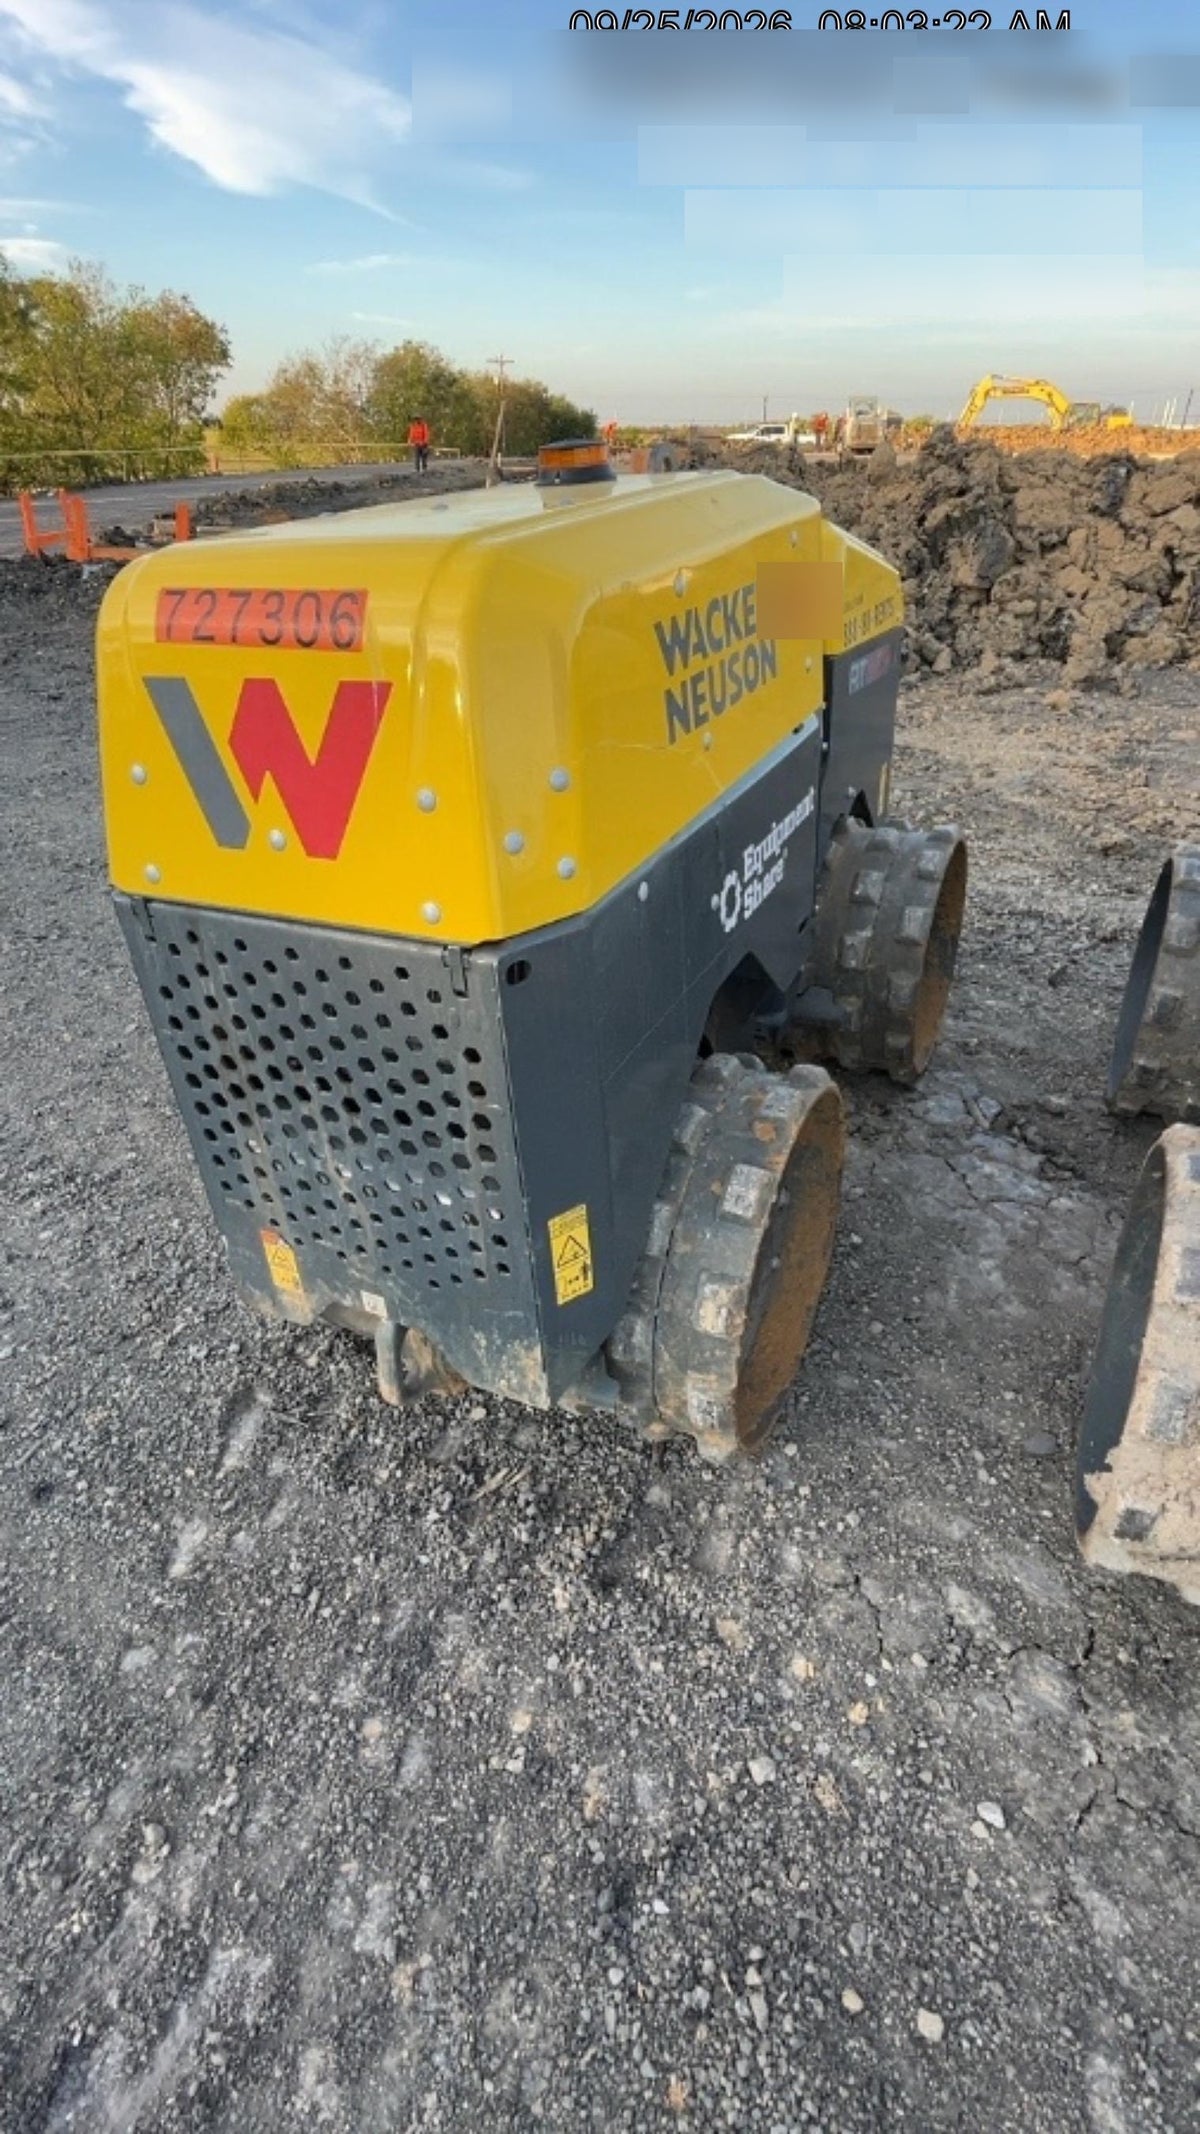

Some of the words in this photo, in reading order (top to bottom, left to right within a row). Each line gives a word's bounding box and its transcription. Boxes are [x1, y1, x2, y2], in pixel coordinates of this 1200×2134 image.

[164, 590, 359, 649] 727306
[653, 582, 758, 678] WACKE
[664, 638, 778, 746] NEUSON
